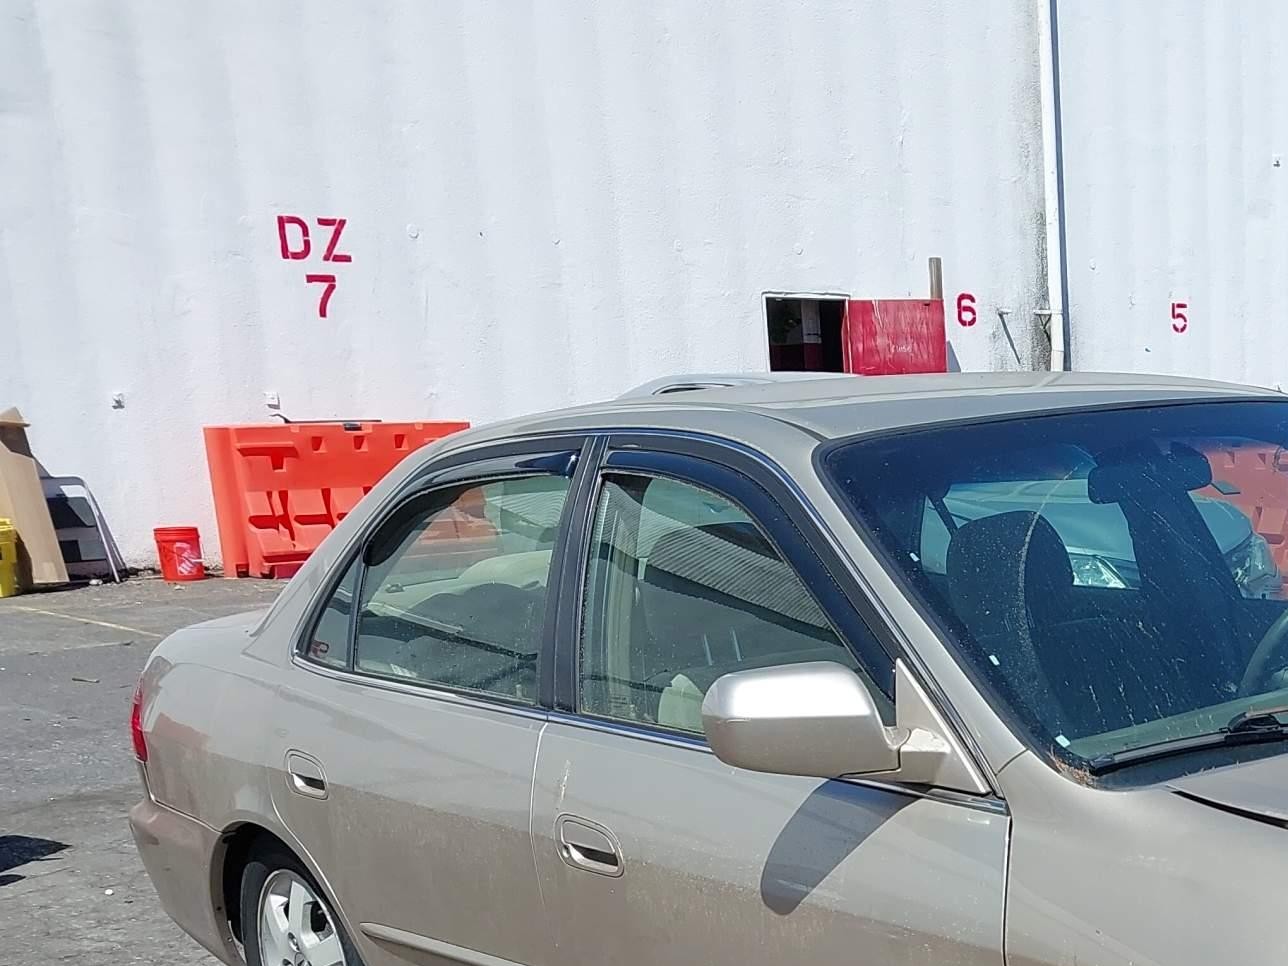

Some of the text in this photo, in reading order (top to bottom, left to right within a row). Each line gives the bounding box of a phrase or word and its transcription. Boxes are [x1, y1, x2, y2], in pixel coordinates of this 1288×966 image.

[277, 215, 352, 263] DZ
[306, 274, 336, 318] 7
[956, 293, 977, 327] 6
[1172, 303, 1187, 333] 5
